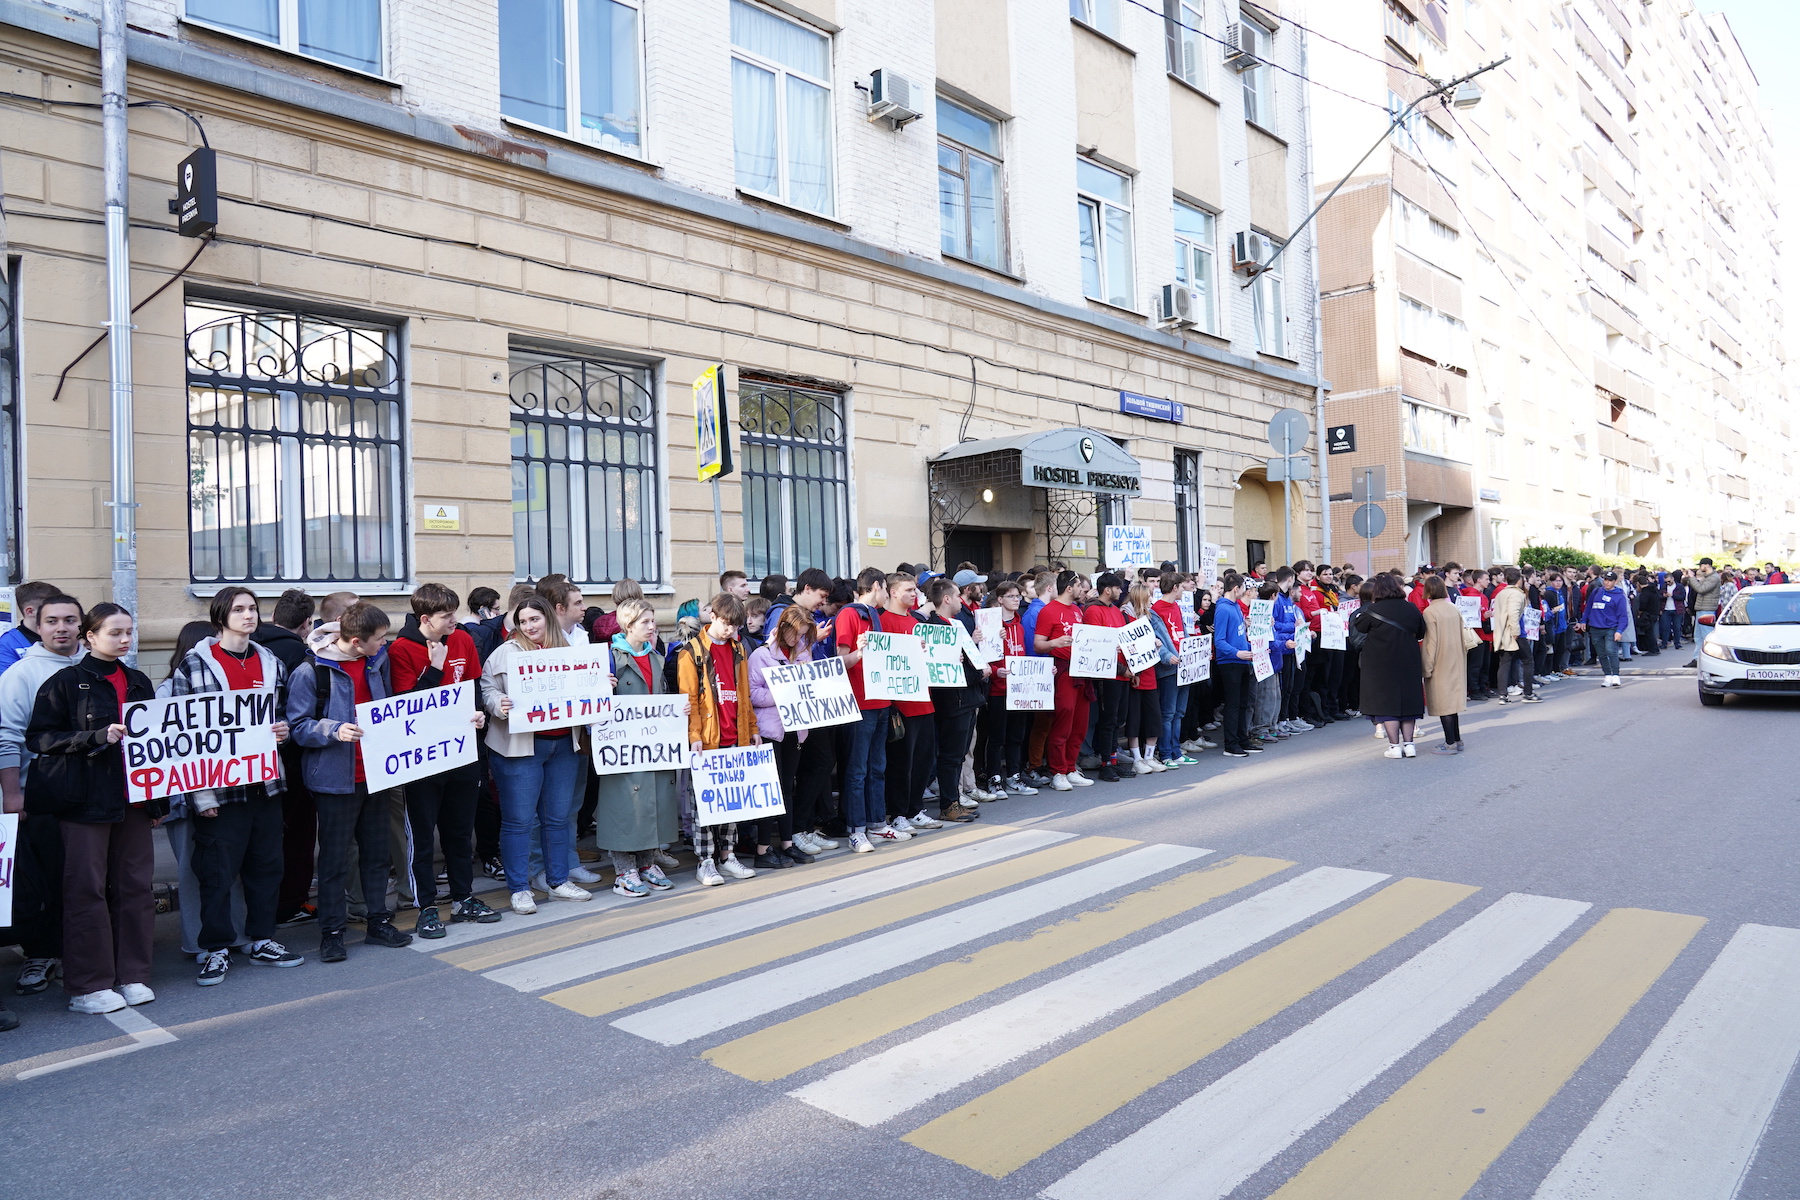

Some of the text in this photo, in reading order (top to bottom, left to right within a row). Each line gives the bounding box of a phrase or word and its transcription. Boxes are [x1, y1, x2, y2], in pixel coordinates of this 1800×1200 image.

[183, 197, 197, 212] HOSTEL
[181, 208, 198, 224] PRESNYA
[1176, 405, 1181, 416] 8
[1033, 465, 1140, 491] HOSTEL PRESNYA
[1113, 538, 1151, 551] НЕ ТРОГАЙ
[1121, 551, 1152, 564] ДЕТЕЙ
[867, 633, 891, 651] РУКИ
[517, 655, 600, 675] ПОЛЬША
[770, 657, 844, 685] ДЕТИ ЭТОГО
[886, 655, 911, 671] ПРОЧЬ
[577, 672, 598, 687] ПО
[798, 684, 815, 699] НЕ
[370, 686, 462, 724] ВАРШАВУ
[527, 696, 611, 723] ДЕТЯМ
[779, 693, 859, 727] ЗАСЛУЖИЛИ
[124, 693, 275, 738] С ДЕТЬМИ
[405, 719, 416, 736] К
[128, 728, 245, 767] ВОЮЮТ
[385, 735, 465, 774] ОТВЕТУ
[690, 753, 699, 770] С
[130, 750, 280, 800] ФАШИСТЫ
[709, 770, 745, 785] ТОЛЬКО
[701, 781, 782, 813] ФАШИСТЫ
